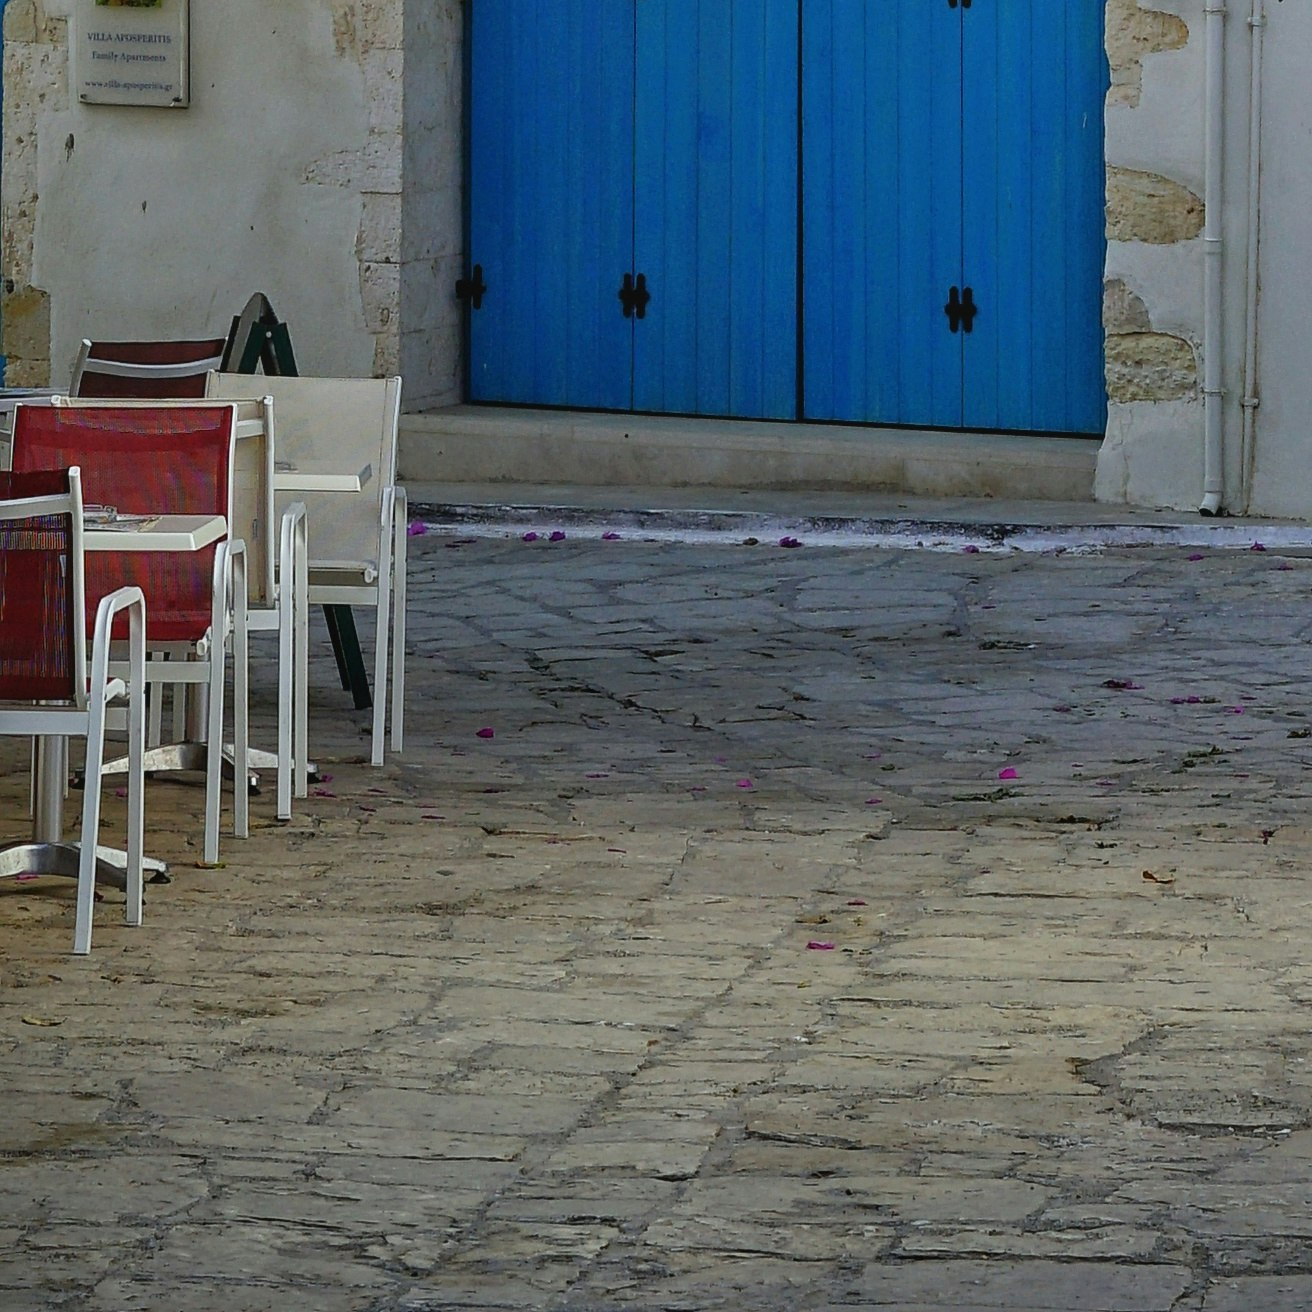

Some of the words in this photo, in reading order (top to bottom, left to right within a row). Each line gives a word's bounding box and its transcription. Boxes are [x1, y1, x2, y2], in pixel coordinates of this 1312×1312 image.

[87, 32, 112, 42] VILLA
[114, 33, 172, 44] APOSPERITIS
[92, 51, 118, 63] Family
[120, 52, 167, 63] Apartments
